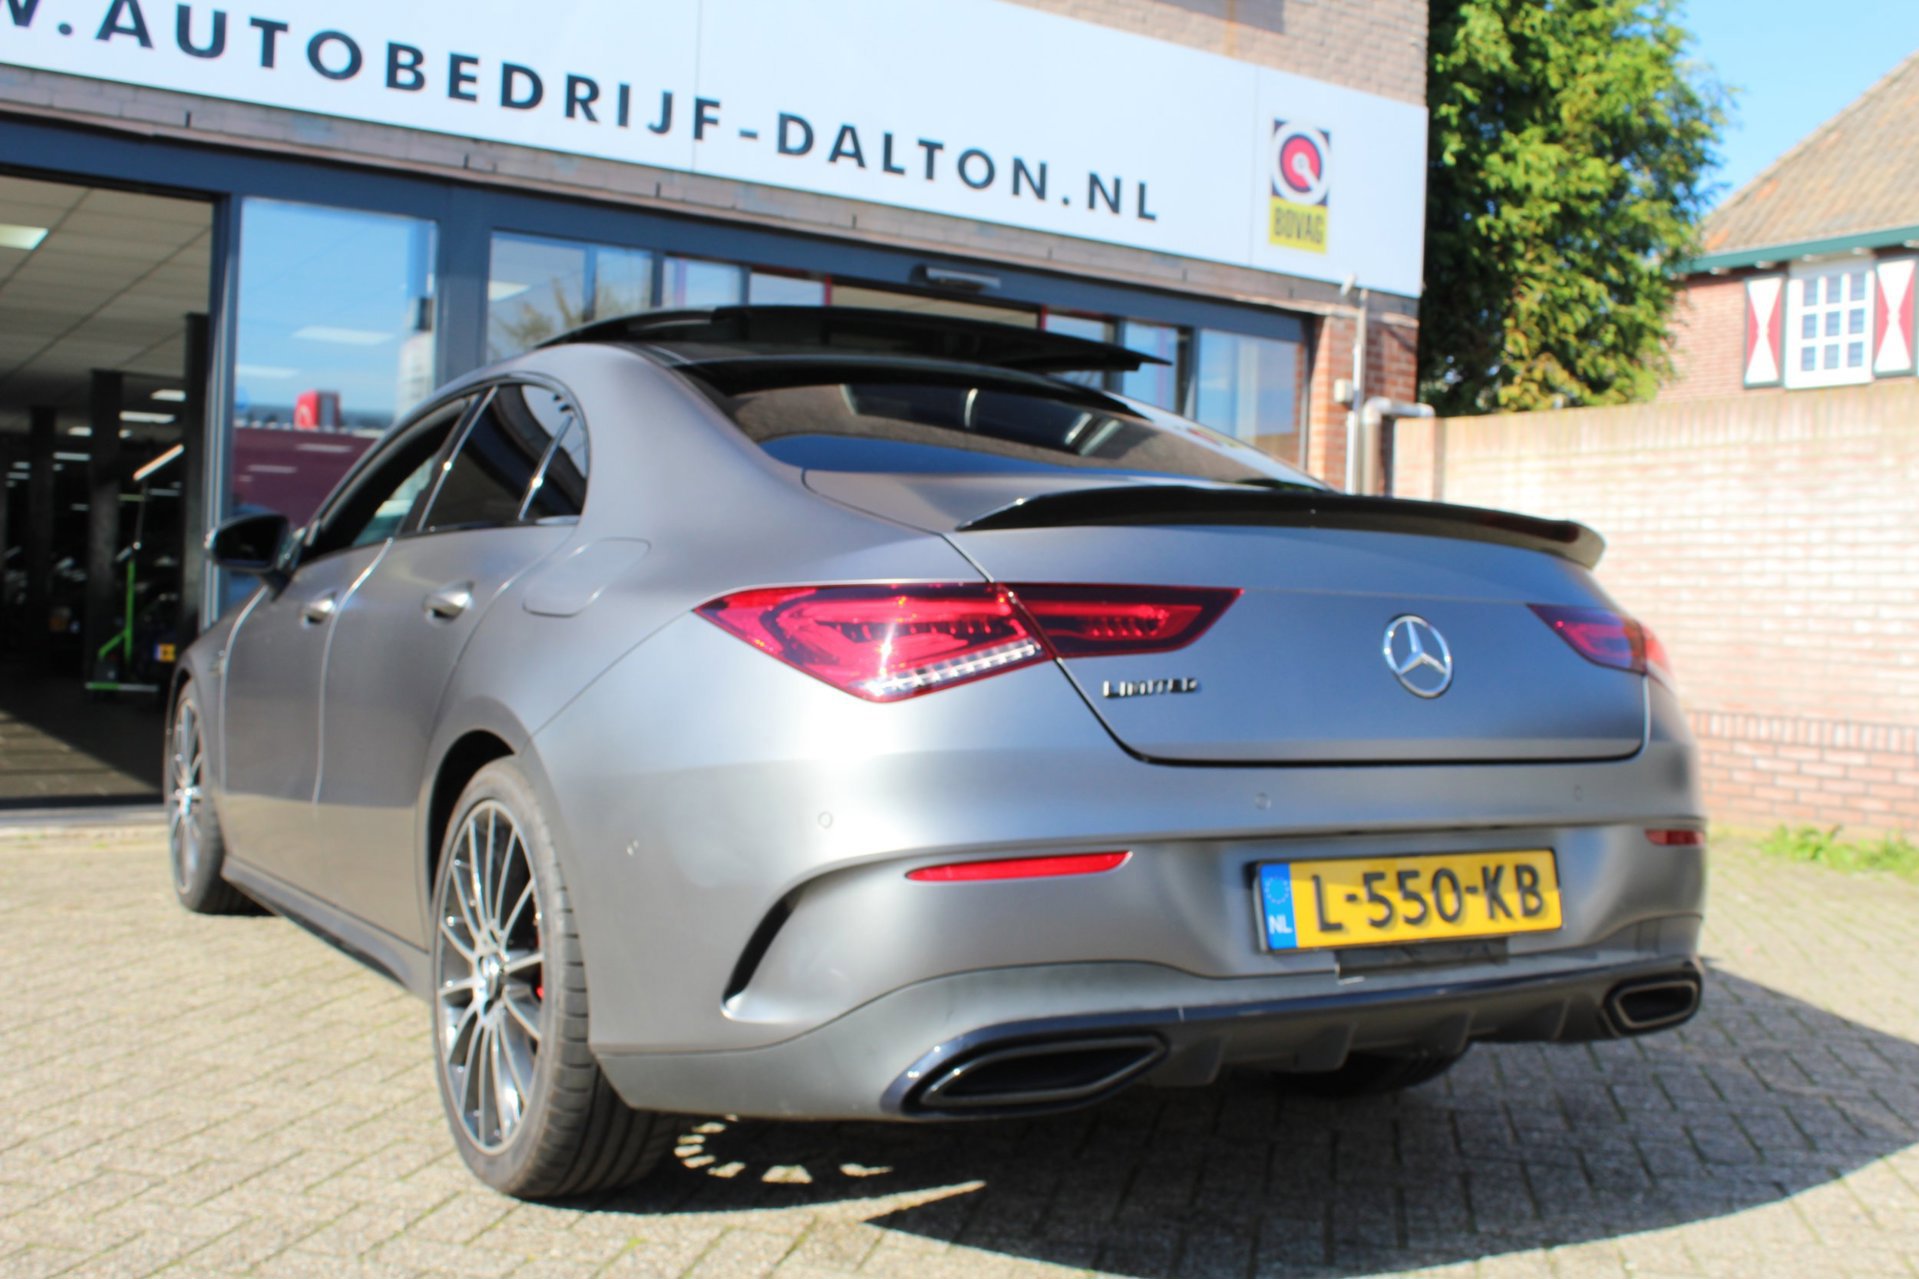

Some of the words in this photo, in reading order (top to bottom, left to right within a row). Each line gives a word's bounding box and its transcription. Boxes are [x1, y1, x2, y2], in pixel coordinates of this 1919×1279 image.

[0, 0, 1157, 221] .AUTOBEDRIJF-DALTON.NL
[1274, 206, 1324, 245] BOVAG
[1268, 915, 1293, 934] NL
[1312, 864, 1544, 932] L-550-KB
